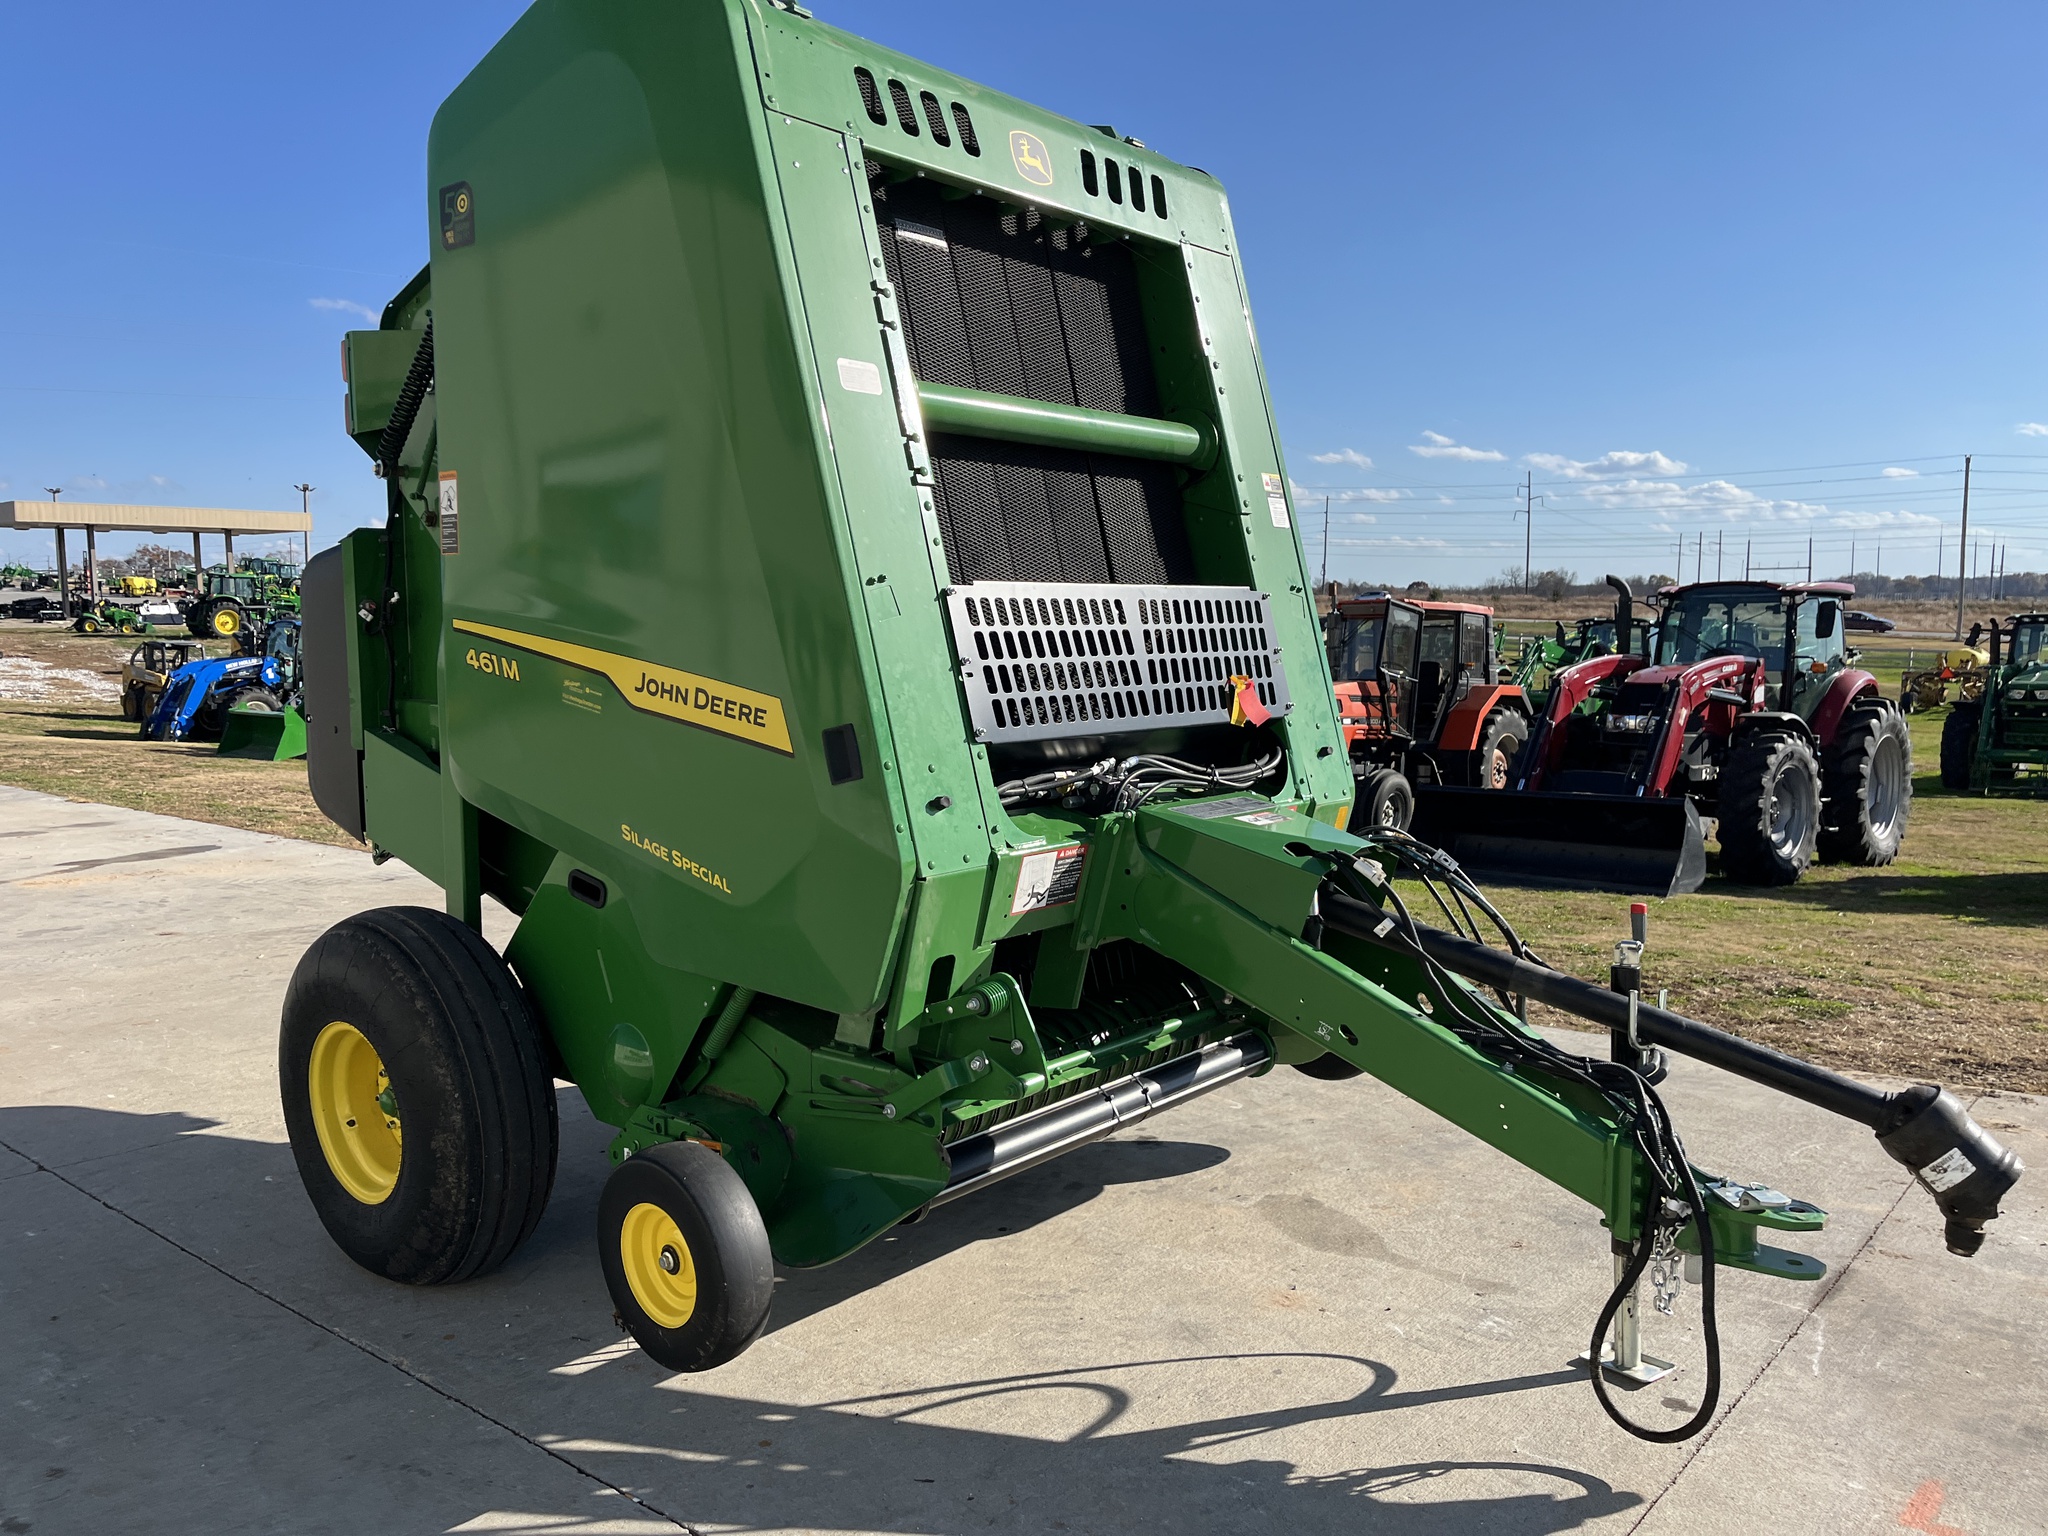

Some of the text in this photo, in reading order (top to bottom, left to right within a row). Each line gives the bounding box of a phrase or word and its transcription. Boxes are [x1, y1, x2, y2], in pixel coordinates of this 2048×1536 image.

[466, 648, 520, 682] 461M
[634, 672, 689, 706] JOHN
[694, 687, 767, 728] DEERE
[621, 824, 732, 894] SILAGE SPECIAL
